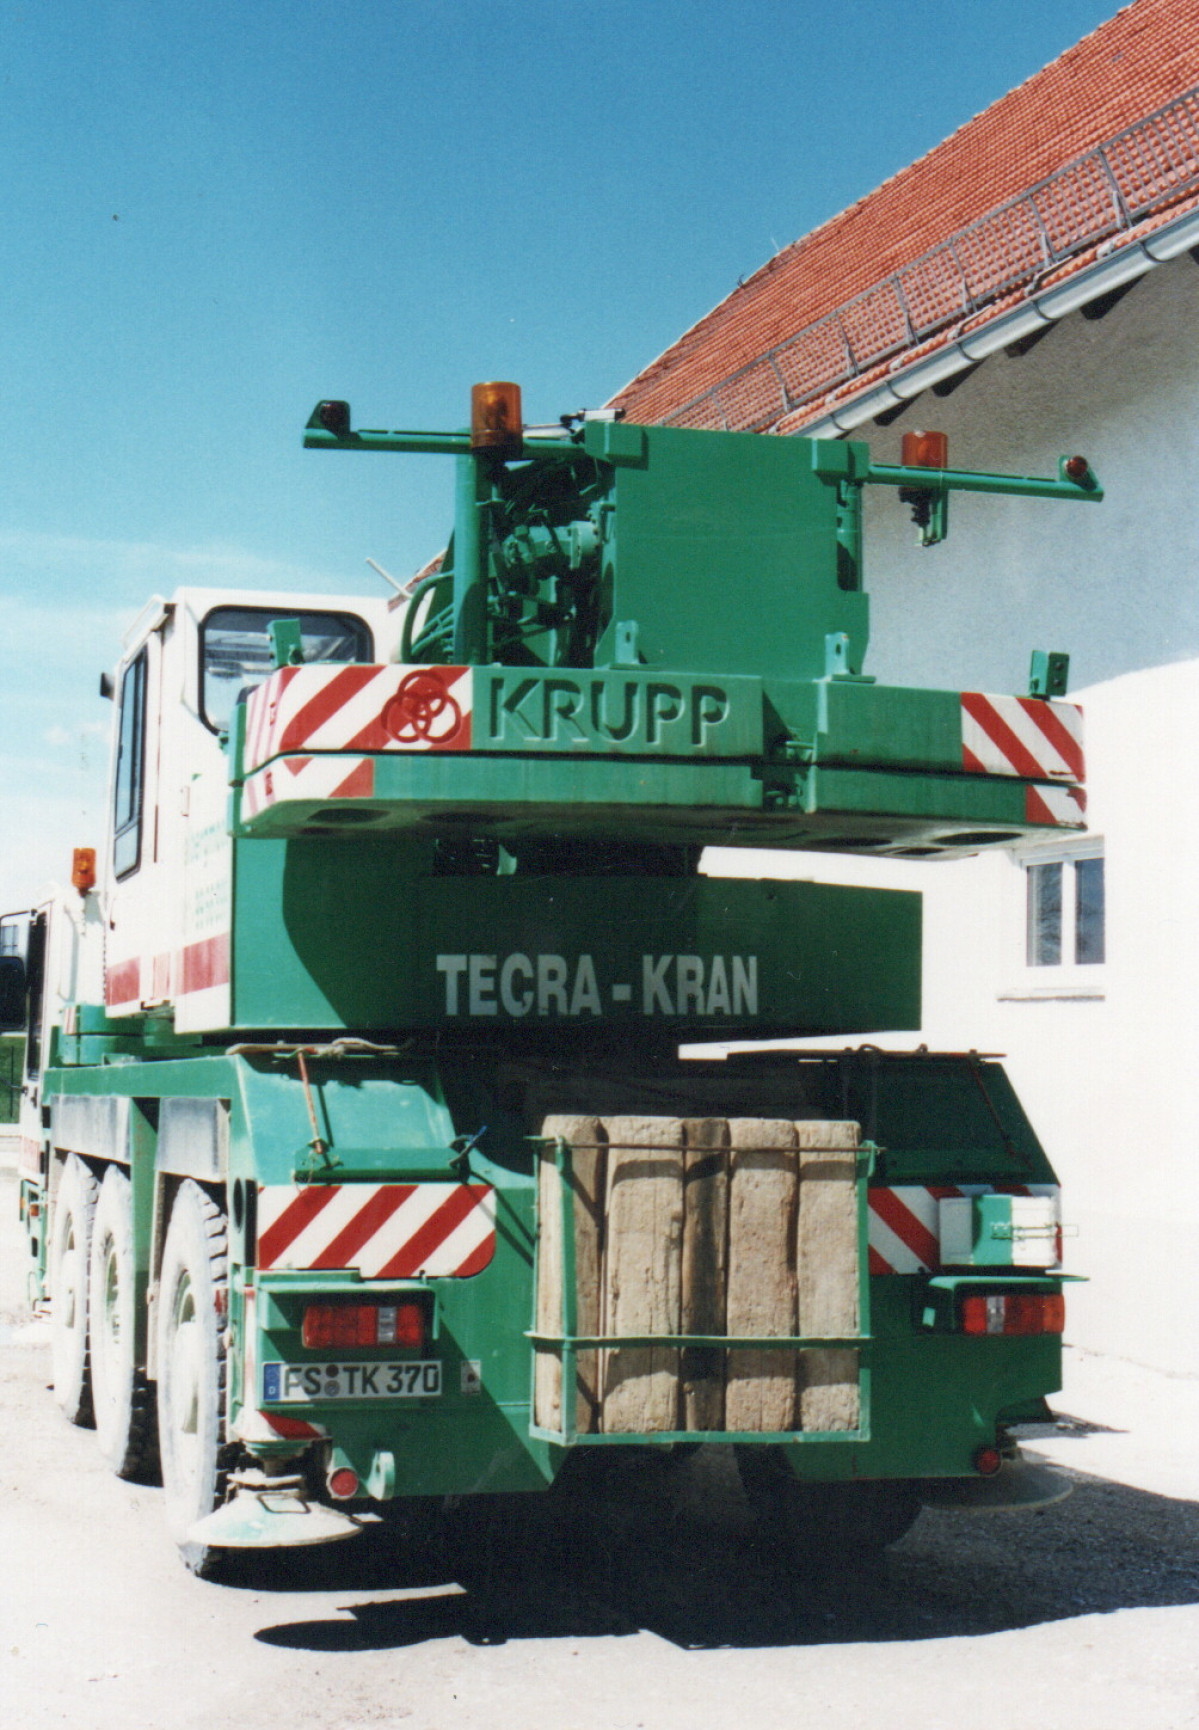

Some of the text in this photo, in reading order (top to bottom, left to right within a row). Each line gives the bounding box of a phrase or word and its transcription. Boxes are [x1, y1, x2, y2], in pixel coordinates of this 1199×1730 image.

[489, 677, 731, 748] KRUPP
[436, 952, 602, 1017] TECRA
[642, 954, 758, 1016] KRAN
[284, 1363, 440, 1397] FS TK 370
